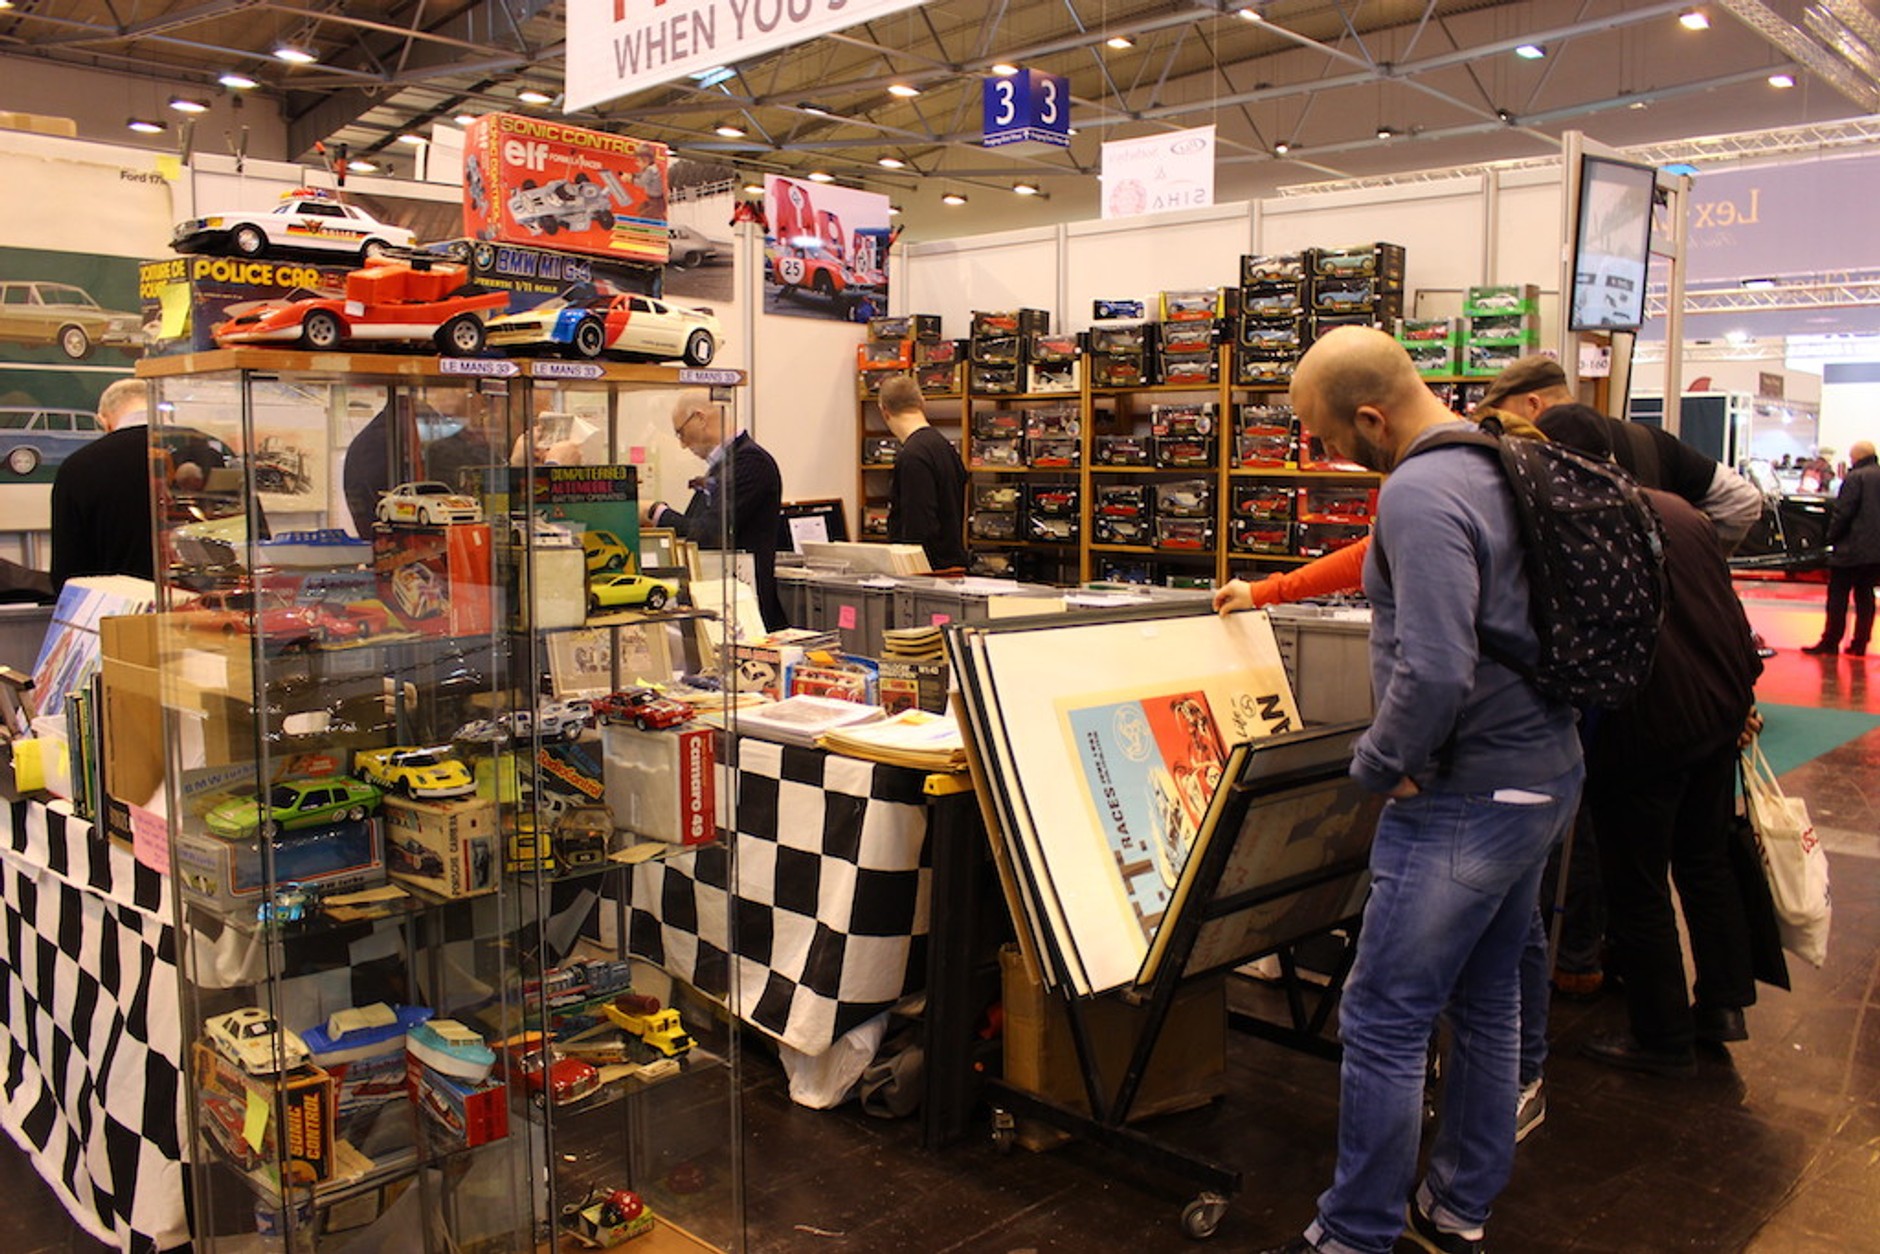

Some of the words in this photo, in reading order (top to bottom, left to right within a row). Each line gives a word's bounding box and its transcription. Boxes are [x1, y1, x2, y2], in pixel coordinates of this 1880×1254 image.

[614, 6, 715, 79] WHEN
[996, 81, 1014, 125] 3
[1041, 80, 1056, 124] 3
[501, 118, 559, 139] SONIC
[562, 128, 666, 160] CONTROL
[504, 139, 549, 171] elf
[121, 170, 147, 183] Ford
[193, 260, 273, 287] POLICE
[276, 267, 319, 290] CAR
[496, 248, 538, 277] BMW
[785, 260, 800, 276] 25
[442, 362, 455, 373] LE
[460, 362, 492, 374] MANS
[534, 364, 547, 375] LE
[550, 364, 581, 376] MANS
[682, 371, 692, 380] LE
[696, 371, 722, 380] MANS
[690, 736, 702, 812] Camaro
[692, 813, 703, 837] 49
[1104, 786, 1134, 849] RACES
[288, 1104, 303, 1157] SONIC
[303, 1091, 320, 1160] CONTROL
